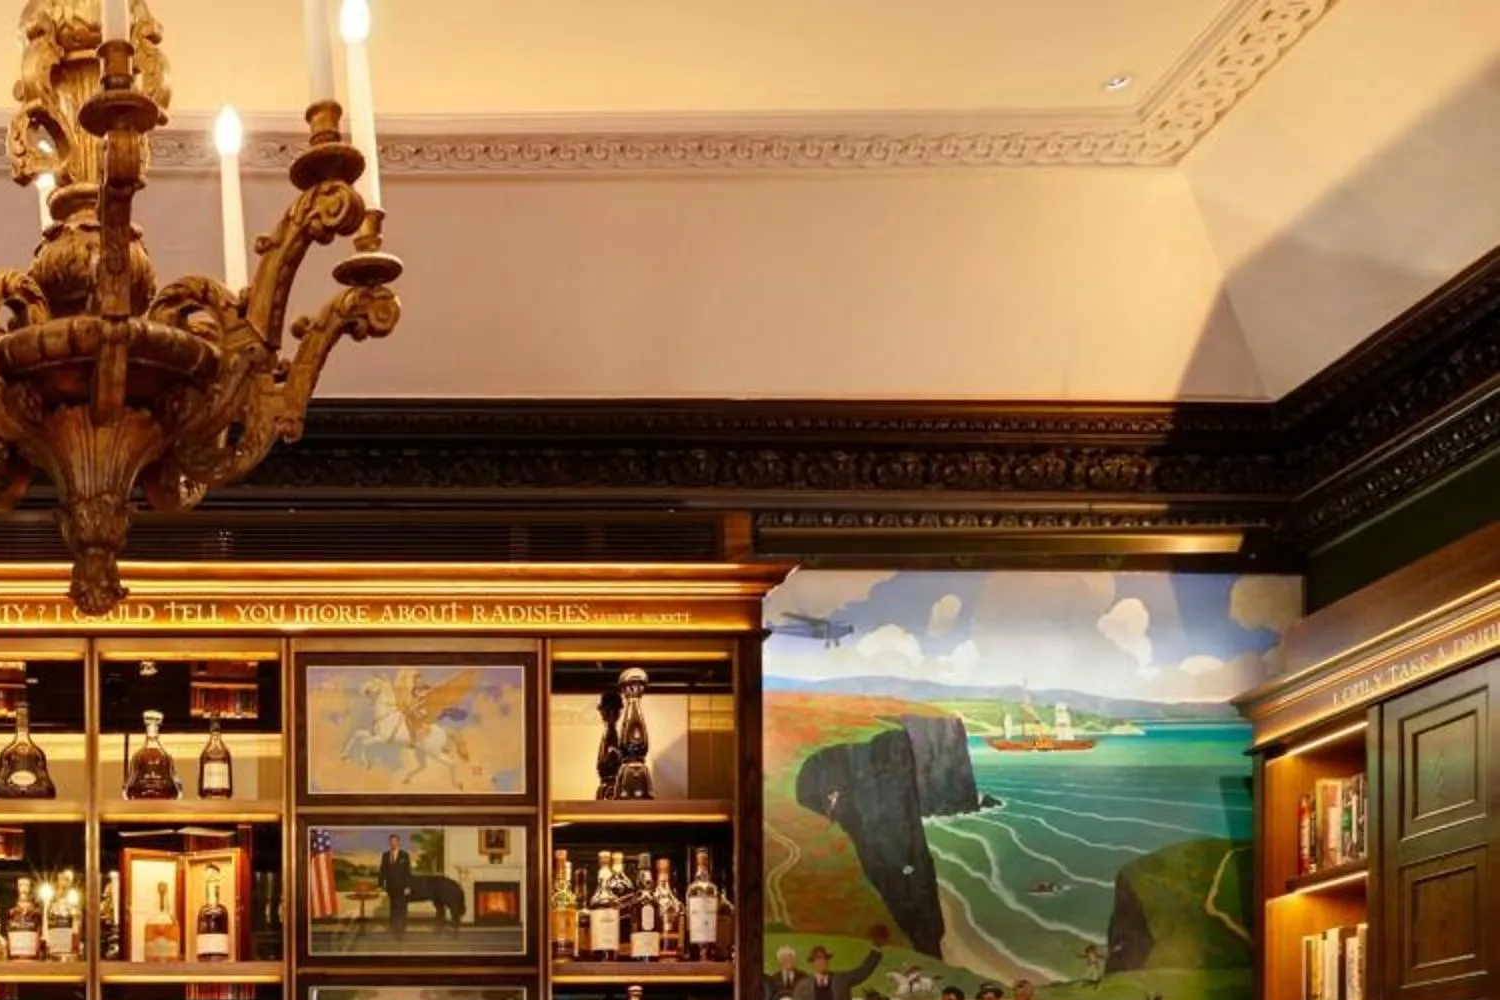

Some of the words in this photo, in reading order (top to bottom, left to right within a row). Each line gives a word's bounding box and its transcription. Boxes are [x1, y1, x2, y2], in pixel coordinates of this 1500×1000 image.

[55, 605, 62, 622] I
[71, 603, 155, 623] CULD
[163, 601, 225, 623] TELL
[235, 604, 286, 623] YOU
[293, 604, 371, 623] MORE
[381, 601, 464, 623] ABOUT
[471, 604, 591, 623] RADISHES
[1388, 653, 1430, 682] TAKE
